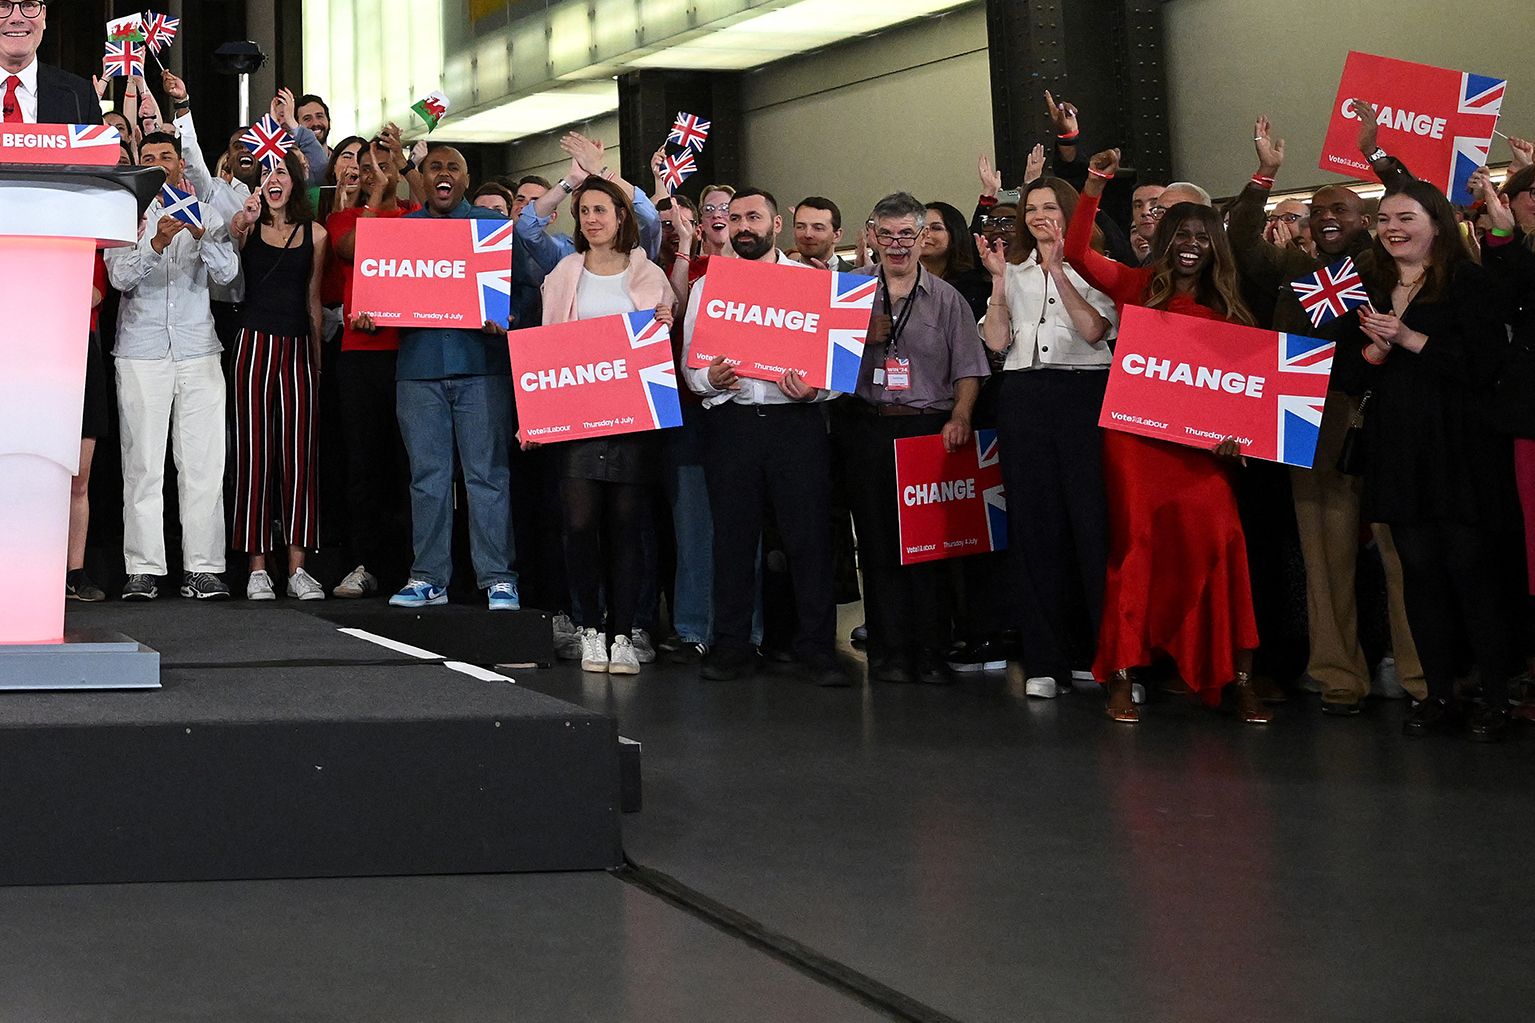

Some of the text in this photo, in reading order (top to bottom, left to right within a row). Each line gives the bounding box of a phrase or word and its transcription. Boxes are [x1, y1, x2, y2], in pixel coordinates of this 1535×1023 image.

[2, 133, 67, 149] BEGINS
[1328, 154, 1370, 171] Vote Labour
[360, 258, 466, 279] CHANGE
[412, 312, 443, 320] Thursday
[449, 312, 464, 321] July
[706, 299, 820, 333] CHANGE
[696, 352, 741, 366] Vote bour
[520, 358, 628, 392] CHANGE
[754, 362, 786, 374] Thursday
[797, 367, 808, 378] uly
[1121, 353, 1266, 398] CHANGE
[582, 419, 614, 429] Thursday
[620, 416, 634, 425] July
[1111, 411, 1168, 429] Vote Labour
[527, 425, 571, 436] Vote Labour
[1184, 426, 1253, 447] Thursday July
[904, 478, 976, 507] CHANGE
[906, 546, 918, 554] Vote
